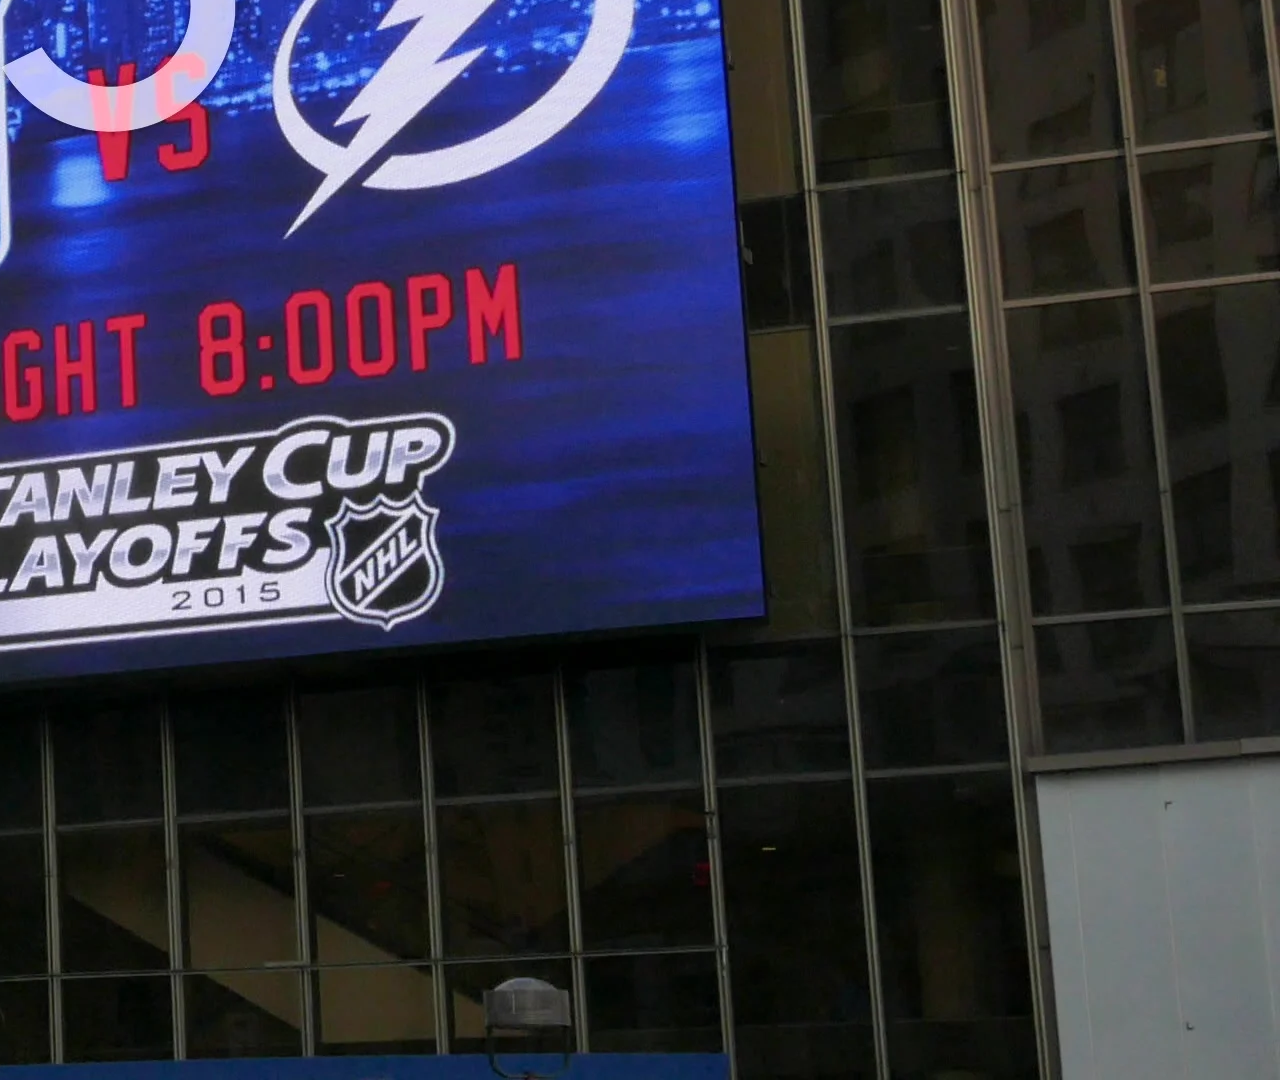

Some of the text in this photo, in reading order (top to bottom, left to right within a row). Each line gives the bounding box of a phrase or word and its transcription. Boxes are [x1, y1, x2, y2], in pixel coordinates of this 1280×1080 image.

[87, 51, 211, 183] VS
[196, 262, 524, 397] 8:00PM
[262, 427, 442, 500] CUP
[170, 580, 283, 611] 2015
[352, 528, 420, 601] NHL
